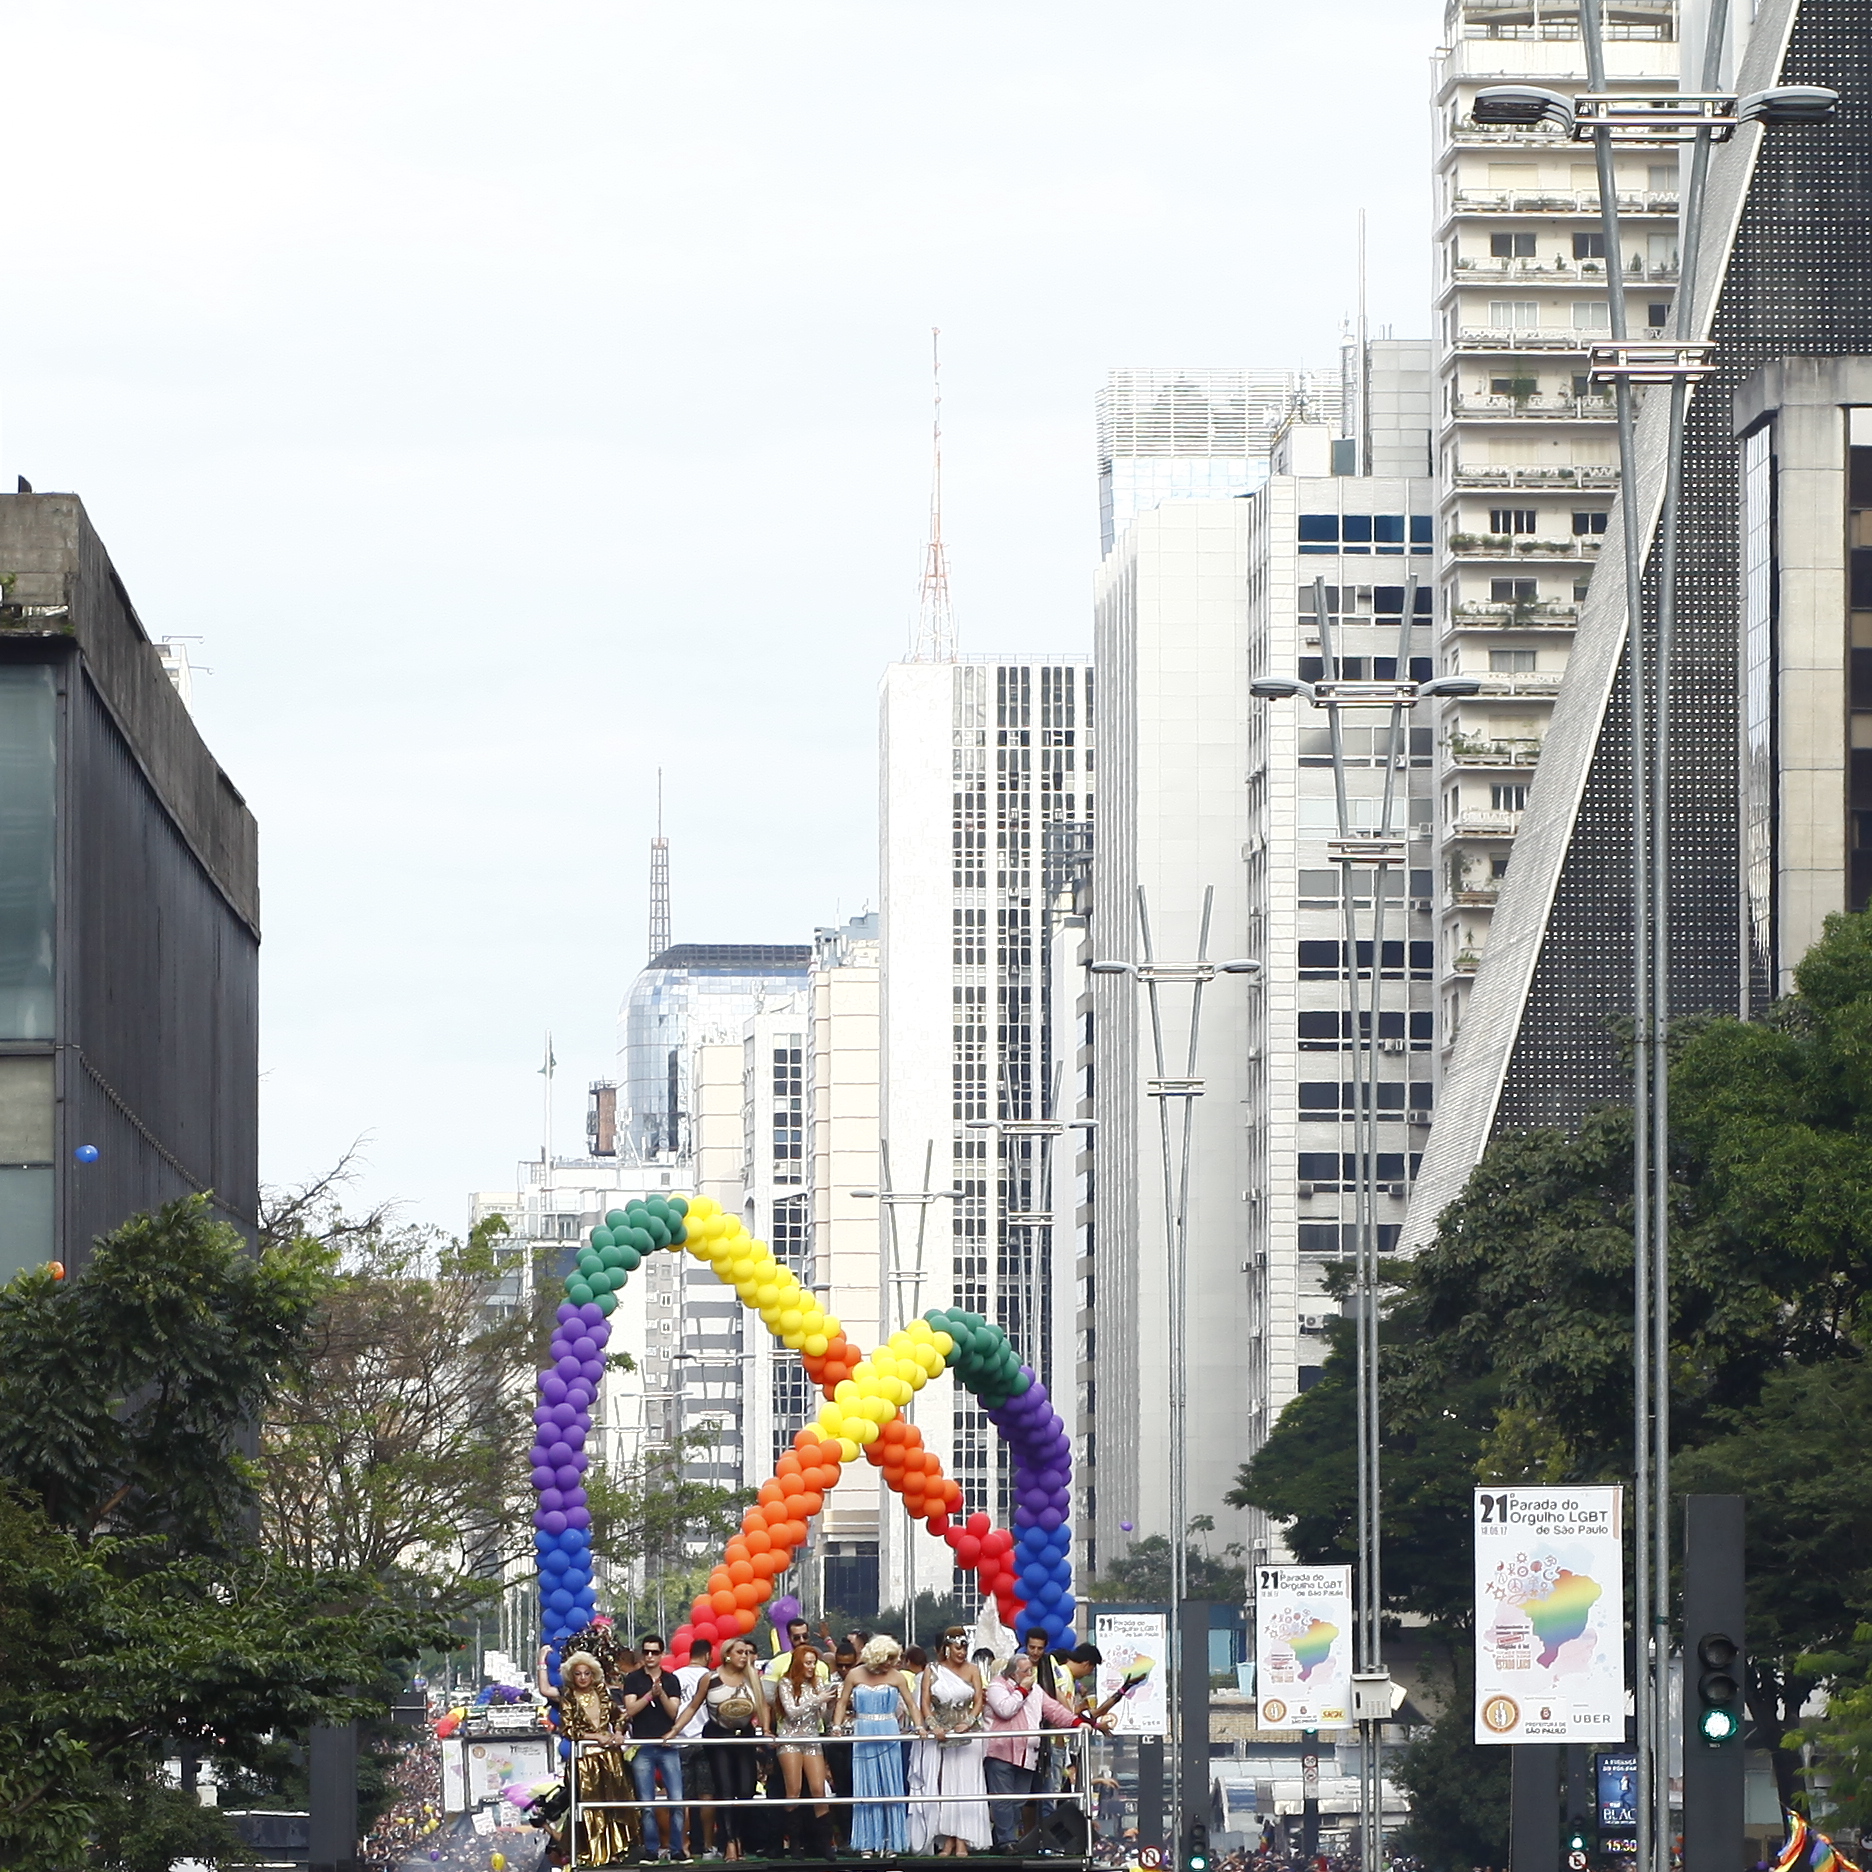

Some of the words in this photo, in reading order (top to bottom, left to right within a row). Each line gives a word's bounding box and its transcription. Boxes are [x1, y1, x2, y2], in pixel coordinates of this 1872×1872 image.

[1510, 1499, 1558, 1511] Parada
[1562, 1499, 1579, 1511] do
[1510, 1511, 1566, 1526] Orgulho
[1569, 1511, 1608, 1523] LGBT
[1536, 1525, 1549, 1535] de
[1554, 1525, 1574, 1535] São
[1578, 1525, 1609, 1535] Paulo
[1318, 1581, 1344, 1590] LGBT
[1572, 1713, 1612, 1724] UBER
